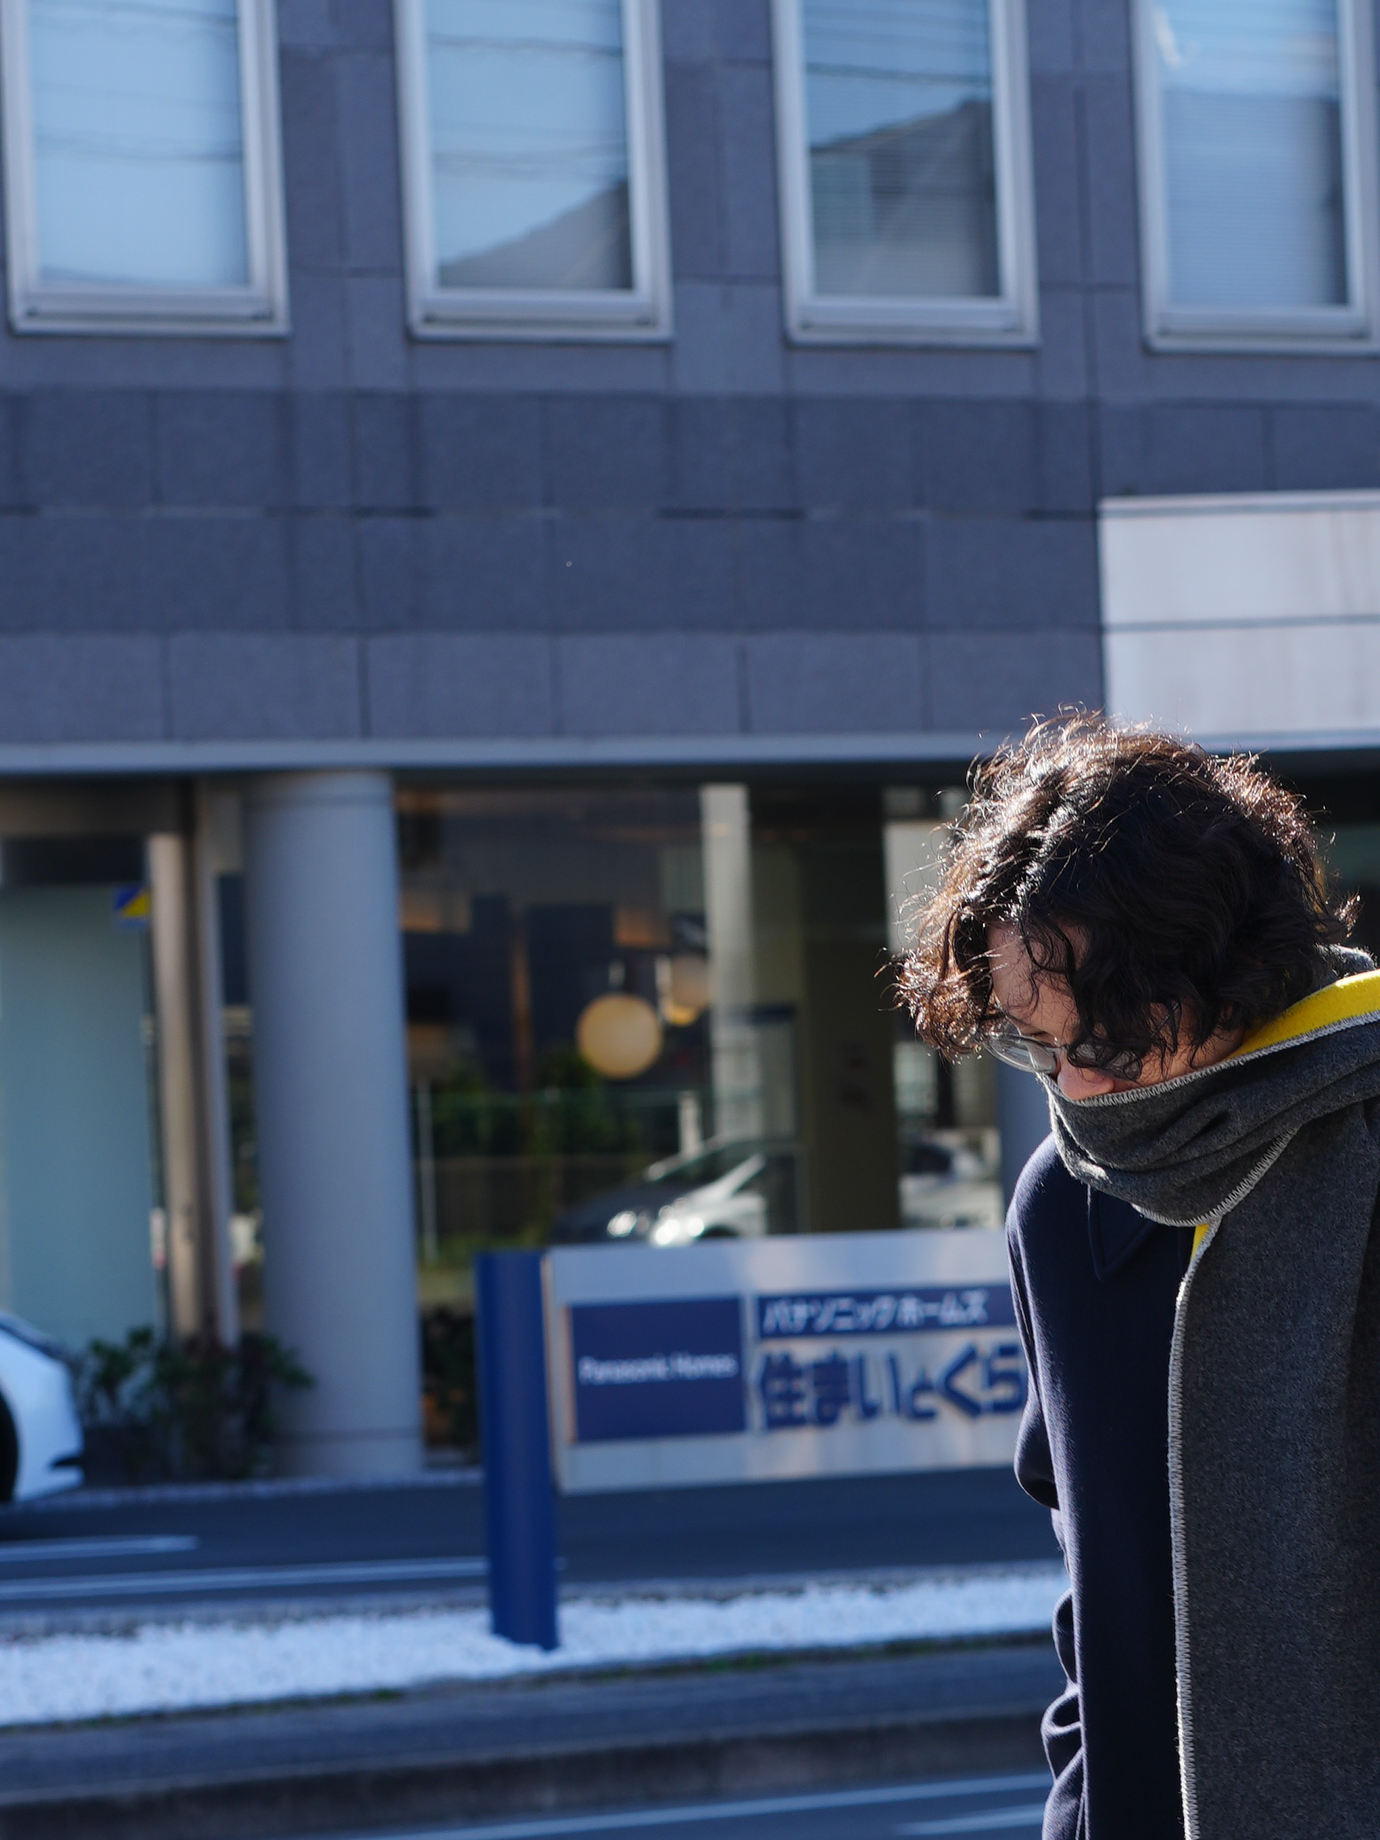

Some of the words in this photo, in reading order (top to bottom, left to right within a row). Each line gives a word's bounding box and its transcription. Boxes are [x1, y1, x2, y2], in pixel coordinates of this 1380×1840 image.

[762, 1289, 988, 1334] パナソニックホームズ
